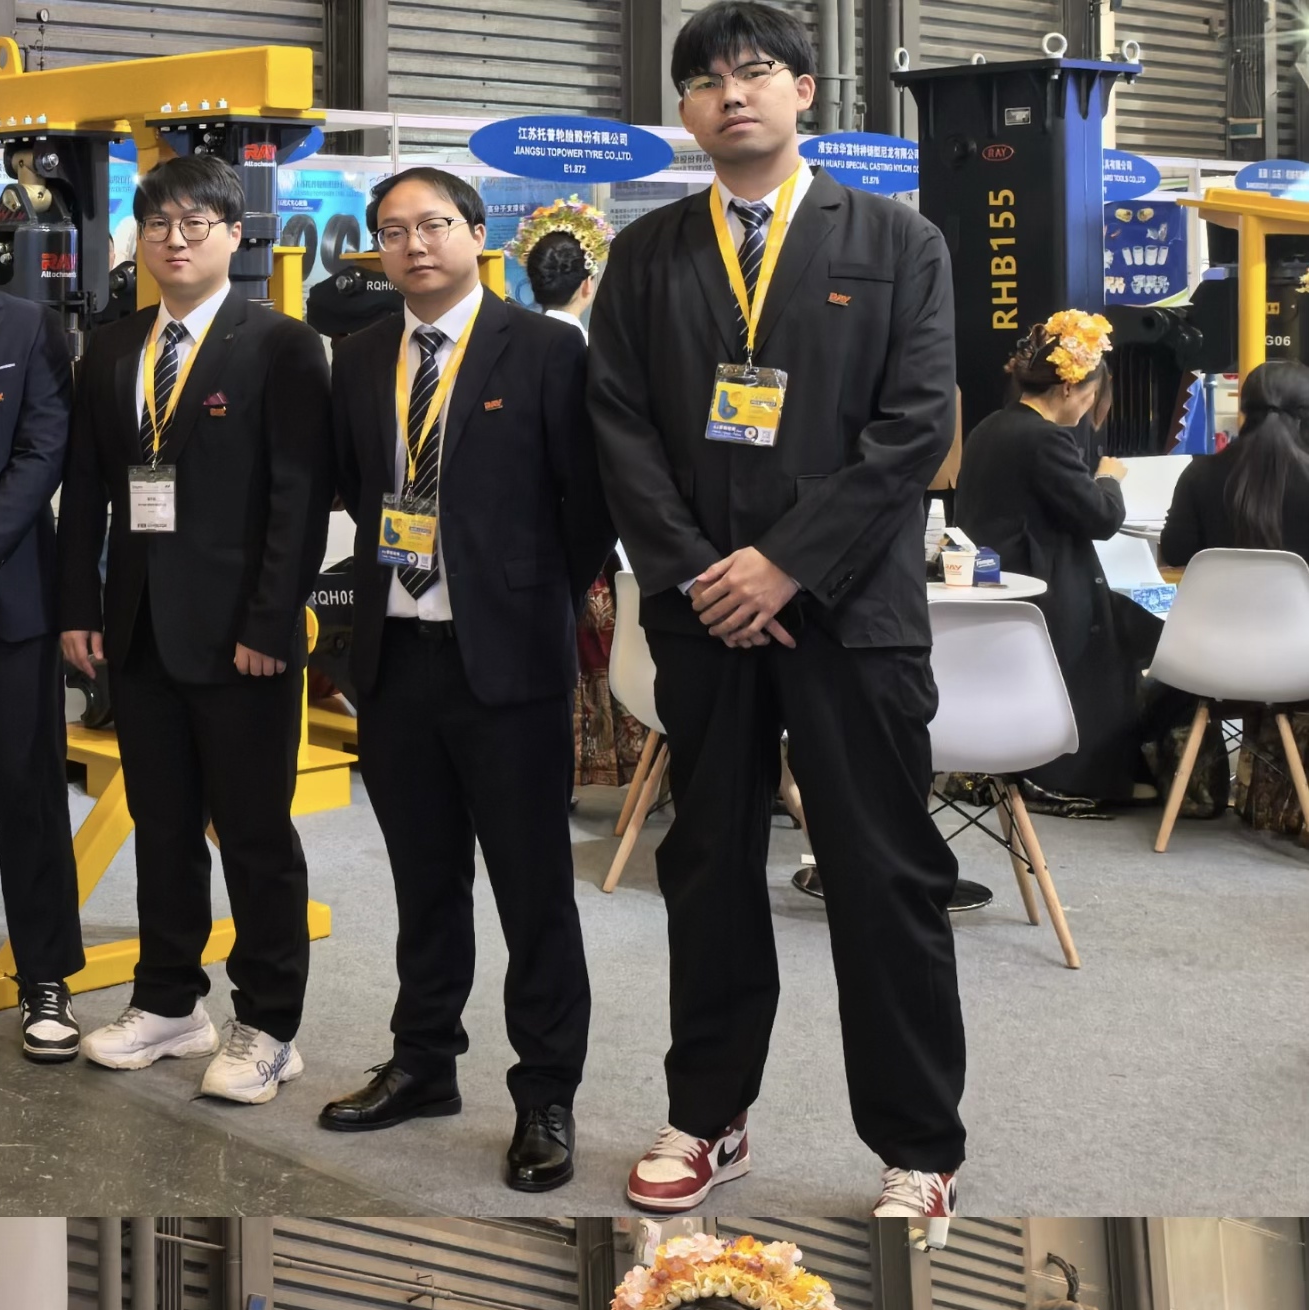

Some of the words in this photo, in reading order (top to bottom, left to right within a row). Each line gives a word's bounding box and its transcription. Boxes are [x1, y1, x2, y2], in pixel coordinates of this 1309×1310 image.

[518, 126, 628, 147] 江苏托普轮胎股份有限公司
[513, 146, 546, 156] JIANGSU
[547, 147, 583, 158] TOPOWER
[585, 149, 603, 160] TYRE
[988, 148, 1007, 158] RAY
[846, 161, 868, 170] SPECIAL
[870, 163, 893, 171] CASTING
[894, 163, 912, 173] NYLON
[989, 189, 1018, 329] RHB155
